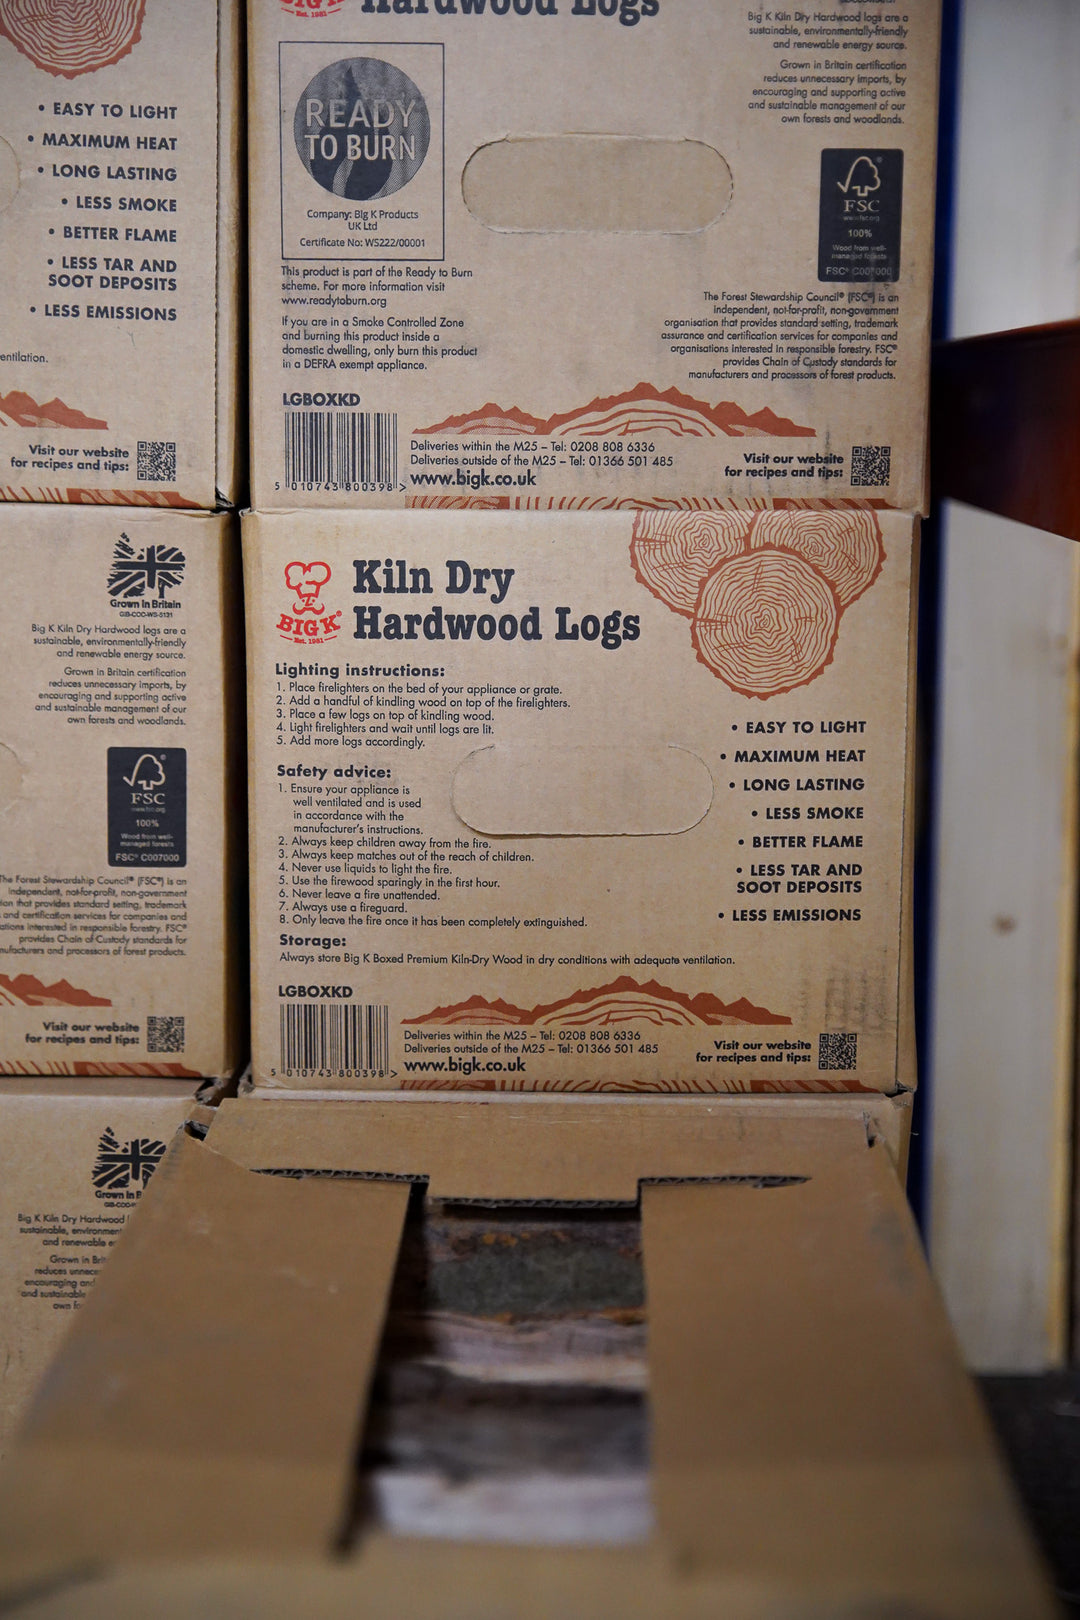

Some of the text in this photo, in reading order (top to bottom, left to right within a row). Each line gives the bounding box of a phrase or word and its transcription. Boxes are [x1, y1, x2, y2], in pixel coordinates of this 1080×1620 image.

[53, 103, 178, 119] EASY TO LIGHT
[306, 99, 416, 127] READY
[42, 133, 178, 150] MAXIMUM HEAT
[305, 135, 416, 160] TO BURN
[53, 164, 177, 181] LONG LASTING
[77, 196, 177, 212] LESS SMOKE
[844, 200, 880, 212] FSC
[307, 209, 419, 221] Company: Big K Products
[348, 221, 378, 231] UK Ltd
[64, 226, 176, 242] BETTER FLAME
[848, 229, 872, 237] 100%
[300, 237, 425, 247] Certificate No: WS222/00001
[62, 256, 177, 272] LESS TAR AND
[281, 265, 473, 280] This product is part of the Ready to Burn
[48, 275, 177, 290] SOOT DEPOSITS
[281, 294, 387, 309] www.readytoburn.org
[45, 305, 177, 321] LESS EMISSIONS
[0, 352, 49, 363] entilation.
[283, 393, 360, 406] LGBOXKD
[29, 445, 55, 456] Visit
[82, 446, 129, 458] website
[744, 453, 844, 464] Visit our website
[11, 458, 129, 474] for recipes and tips:
[410, 470, 536, 490] www.bigk.co.uk
[725, 467, 843, 480] for recipes and tips:
[353, 560, 515, 603] Kiln Dry
[353, 606, 640, 650] Hardwood Logs
[64, 667, 186, 677] Grown in Britain certification
[276, 663, 445, 680] Lighting instructions:
[277, 681, 562, 698] 1. Place firelighters on the bed of your appliance or grate.
[276, 721, 494, 737] 4. Light firelighters and wait until logs are lit.
[746, 721, 867, 733] EASY TO LIGHT
[276, 734, 425, 750] 5. Add more logs accordingly.
[734, 750, 866, 762] MAXIMUM HEAT
[277, 764, 391, 781] Safety advice:
[744, 779, 865, 791] LONG LASTING
[132, 792, 165, 804] FSC
[766, 807, 864, 820] LESS SMOKE
[136, 819, 159, 828] 100%
[753, 836, 863, 848] BETTER FLAME
[751, 864, 862, 876] LESS TAR AND
[737, 881, 862, 893] SOOT DEPOSITS
[733, 910, 861, 921] LESS EMISSIONS
[280, 934, 346, 950] Storage:
[279, 985, 353, 998] LGBOXKD
[43, 1022, 68, 1032] Visit
[94, 1022, 140, 1032] website
[25, 1034, 139, 1047] for recipes and tips:
[714, 1039, 740, 1050] Visit
[766, 1040, 812, 1050] website
[696, 1052, 811, 1065] for recipes and tips:
[404, 1057, 526, 1076] www.bigk.co.uk
